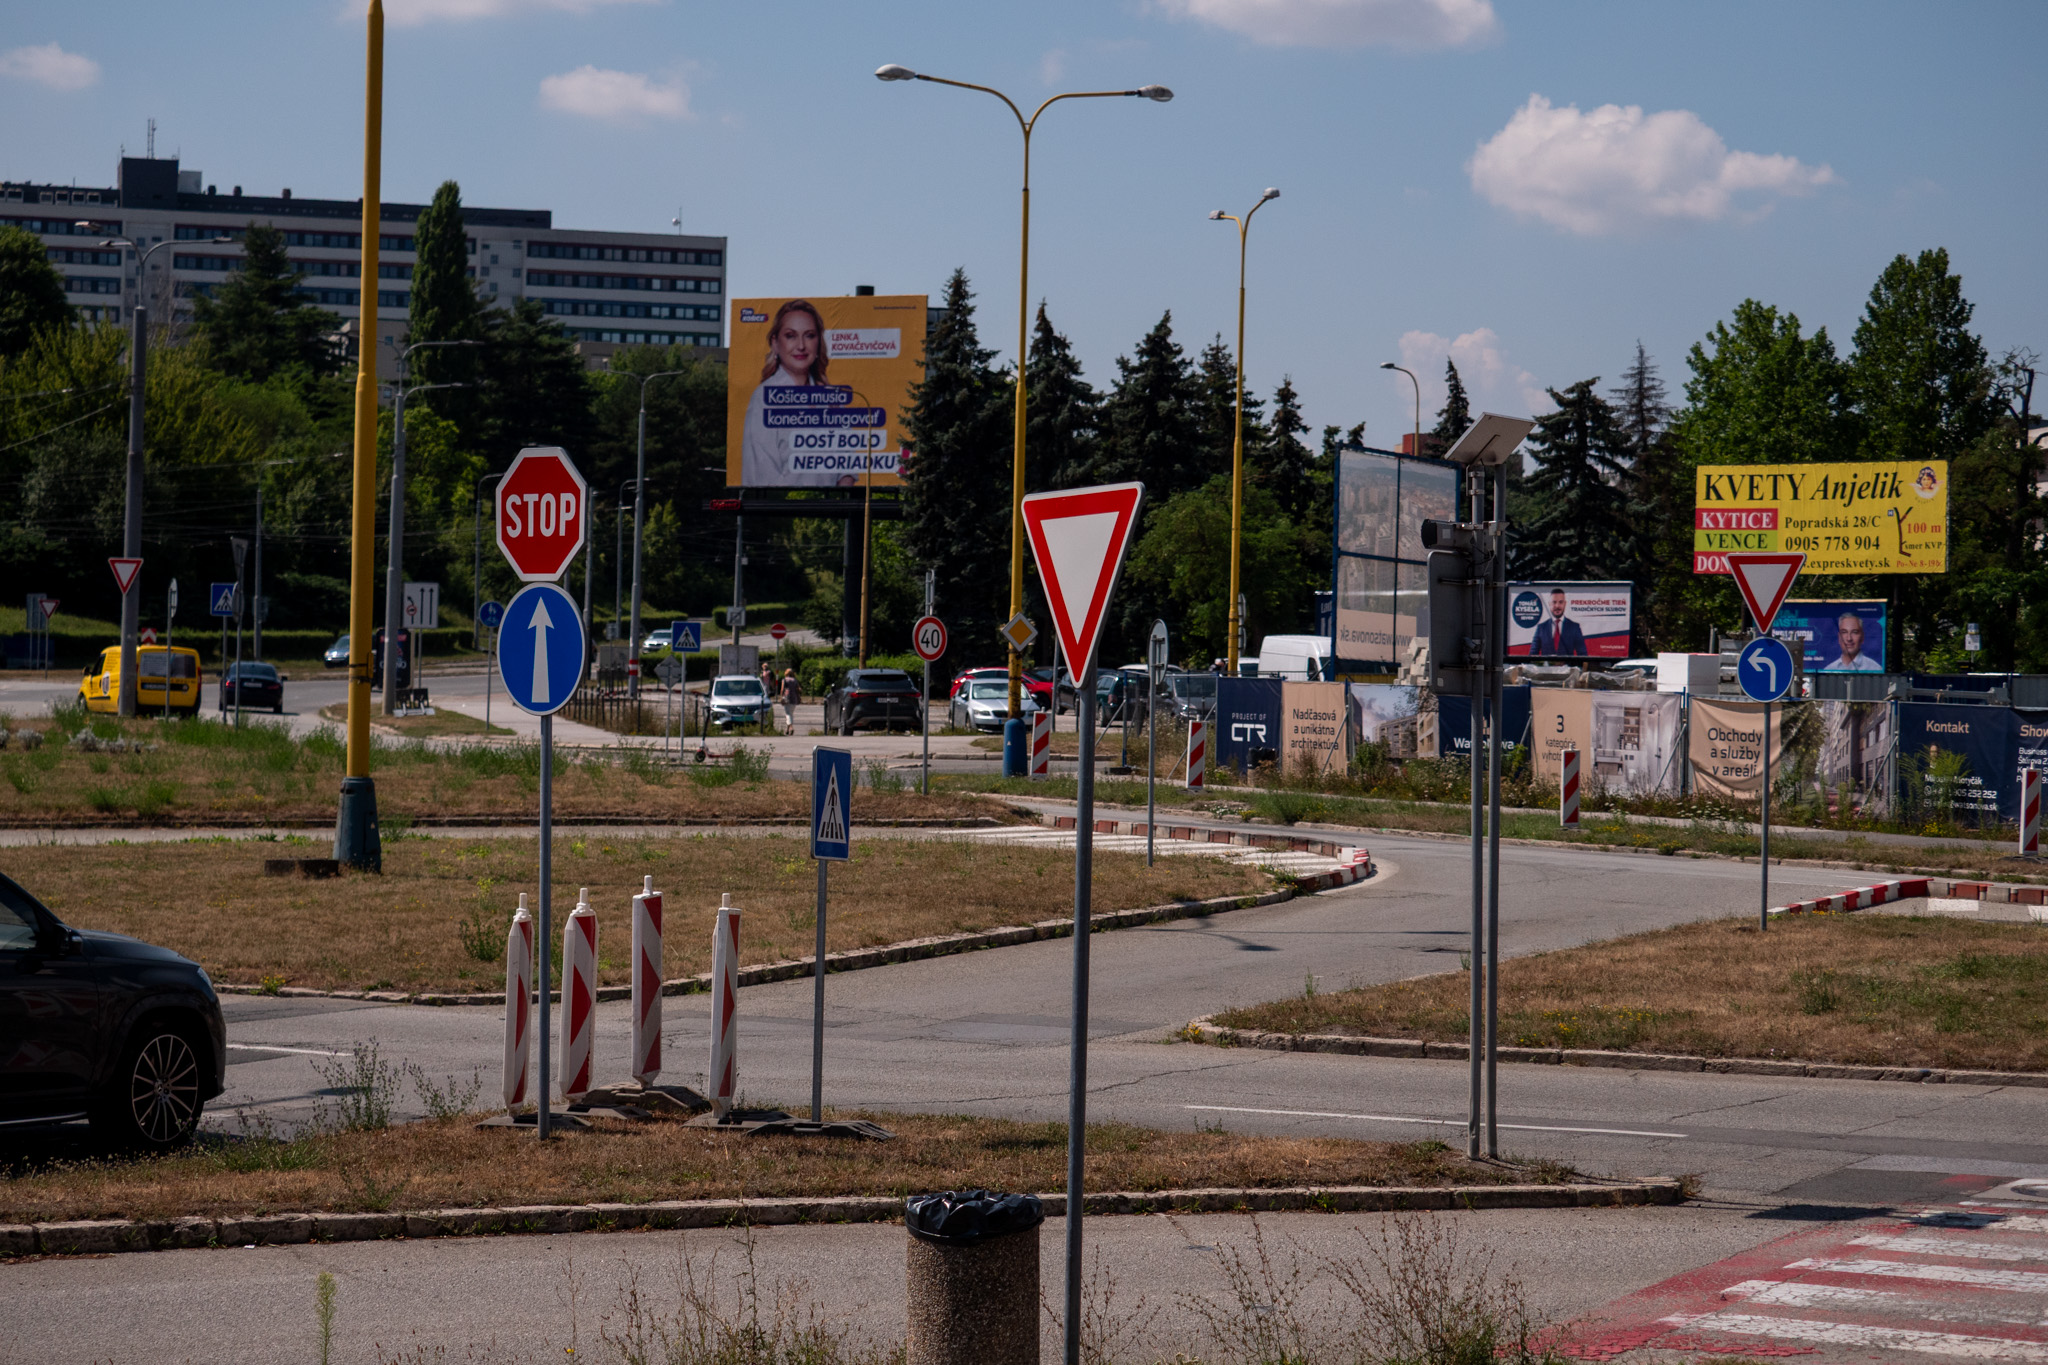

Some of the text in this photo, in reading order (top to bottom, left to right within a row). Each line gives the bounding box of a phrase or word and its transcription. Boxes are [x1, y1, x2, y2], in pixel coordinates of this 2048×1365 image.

[831, 333, 859, 342] LENKA
[768, 388, 808, 404] Košice
[767, 409, 880, 429] konečne fungovať
[794, 431, 880, 448] DOSŤ BOLO
[793, 455, 896, 469] NEPORIADKU
[1703, 472, 1905, 508] KVETY Anjelik
[504, 492, 577, 538] STOP
[1701, 512, 1773, 528] KYTICE
[1785, 515, 1881, 532] Popradská 28/C
[1907, 523, 1942, 534] 100 m
[1705, 534, 1768, 549] VENCE
[1785, 535, 1881, 551] 0905 778 904
[1803, 557, 1890, 571] .expreskvety.sk
[921, 629, 940, 649] 40
[1232, 712, 1267, 721] PROJECT OF
[1292, 708, 1336, 721] Nadčasová
[1293, 724, 1335, 736] a unikátna
[1556, 714, 1565, 733] 3
[1925, 719, 1970, 734] Kontakt
[1231, 723, 1267, 743] CTR
[1707, 727, 1763, 746] Obchody
[1710, 746, 1761, 763] a služby
[1712, 764, 1757, 778] v areáli
[1967, 789, 1982, 798] 252
[1982, 790, 1998, 799] 252
